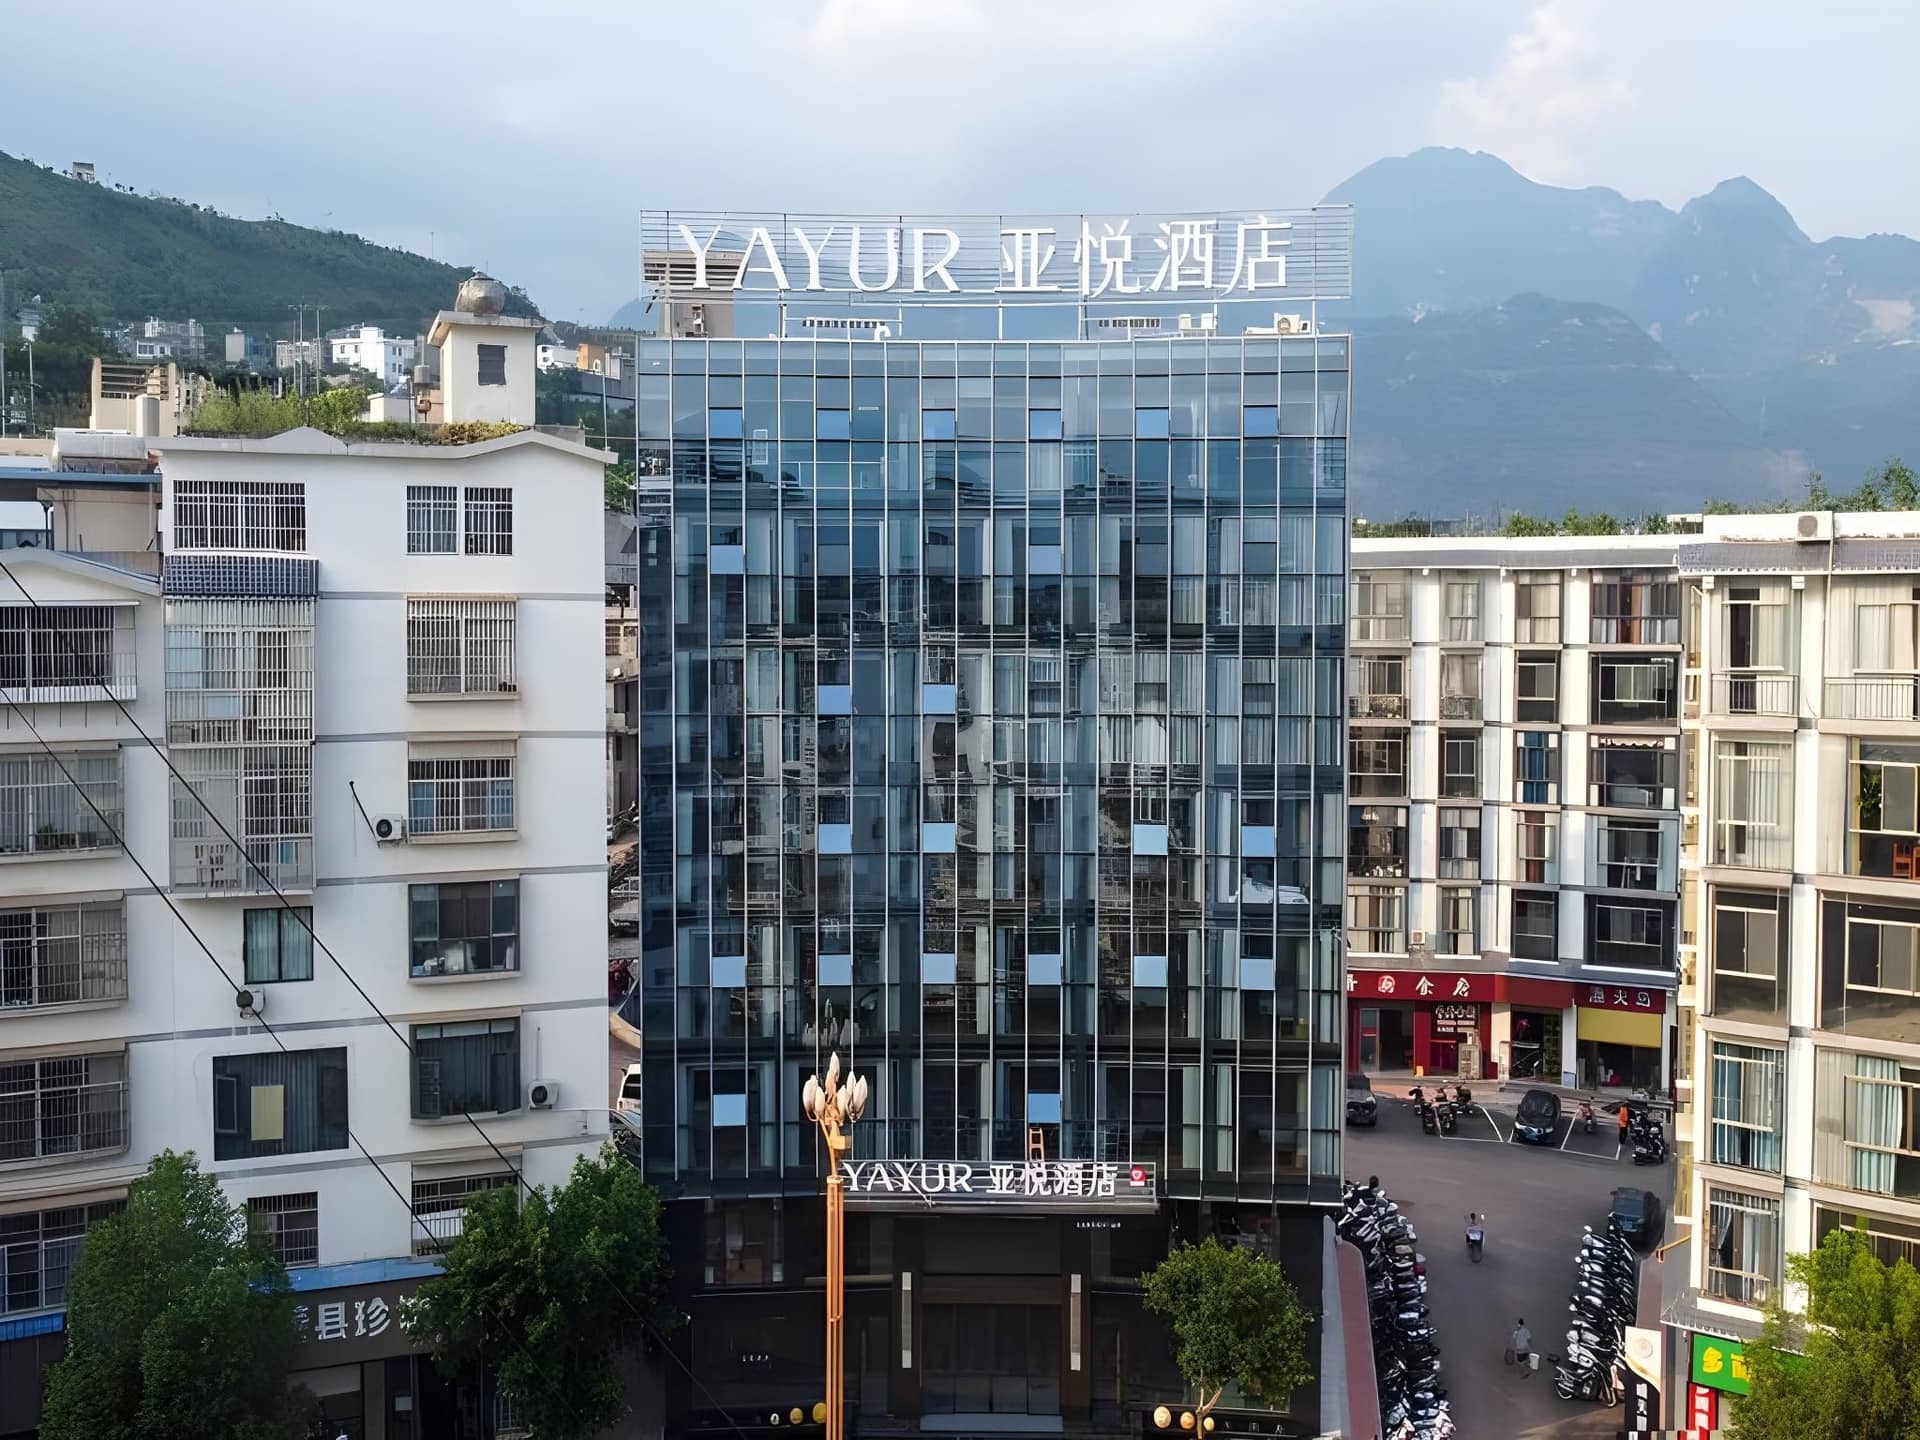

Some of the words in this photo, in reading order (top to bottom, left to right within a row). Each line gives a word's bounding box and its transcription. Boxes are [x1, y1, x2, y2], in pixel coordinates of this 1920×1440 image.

[677, 223, 962, 293] YAYUR
[994, 215, 1293, 297] 亚悦酒店
[841, 1161, 973, 1193] YAYUR
[986, 1162, 1118, 1197] 亚悦酒店
